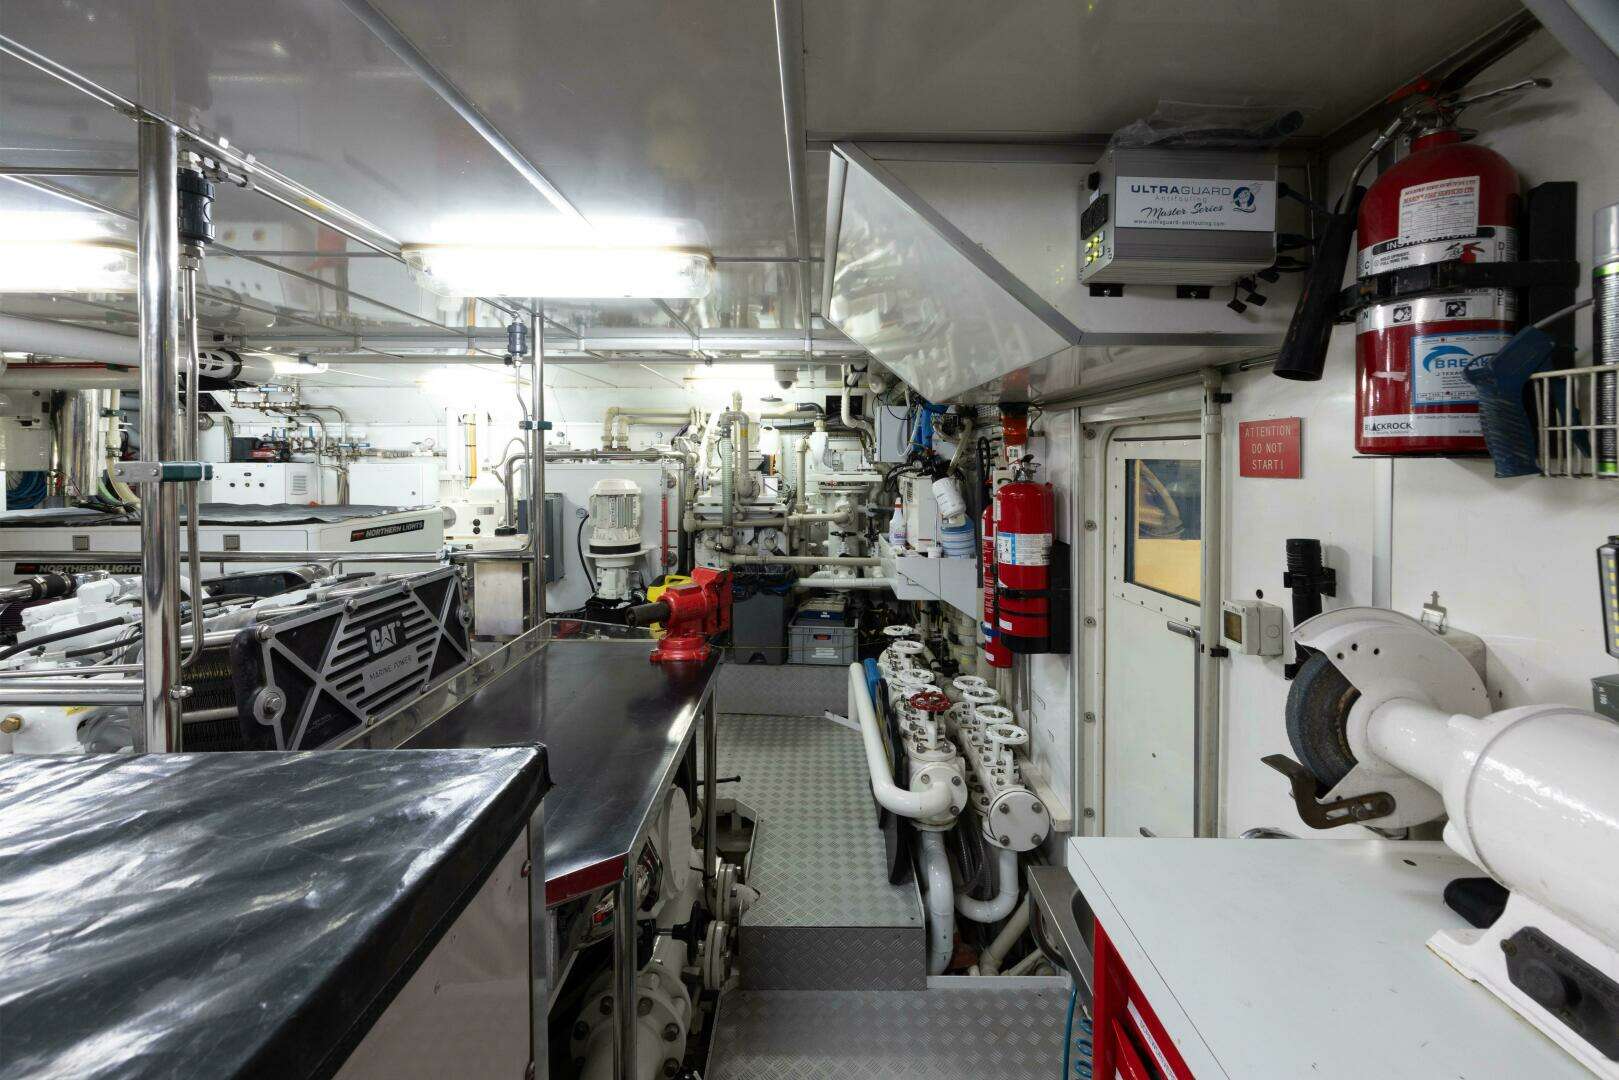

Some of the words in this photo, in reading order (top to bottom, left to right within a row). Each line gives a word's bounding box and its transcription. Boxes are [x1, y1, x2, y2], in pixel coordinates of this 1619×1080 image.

[1131, 184, 1231, 196] ULTRAGUARD
[1140, 206, 1187, 219] Master
[1190, 203, 1224, 215] Series
[1245, 424, 1291, 438] ATTENTION
[1251, 443, 1262, 455] DO
[1266, 442, 1282, 454] NOT
[366, 525, 401, 537] NORTHERN
[402, 521, 424, 531] LIGHTS
[106, 564, 142, 574] LIGHT
[370, 621, 397, 654] CAT
[369, 664, 392, 681] MARINE
[394, 654, 411, 669] POWER
